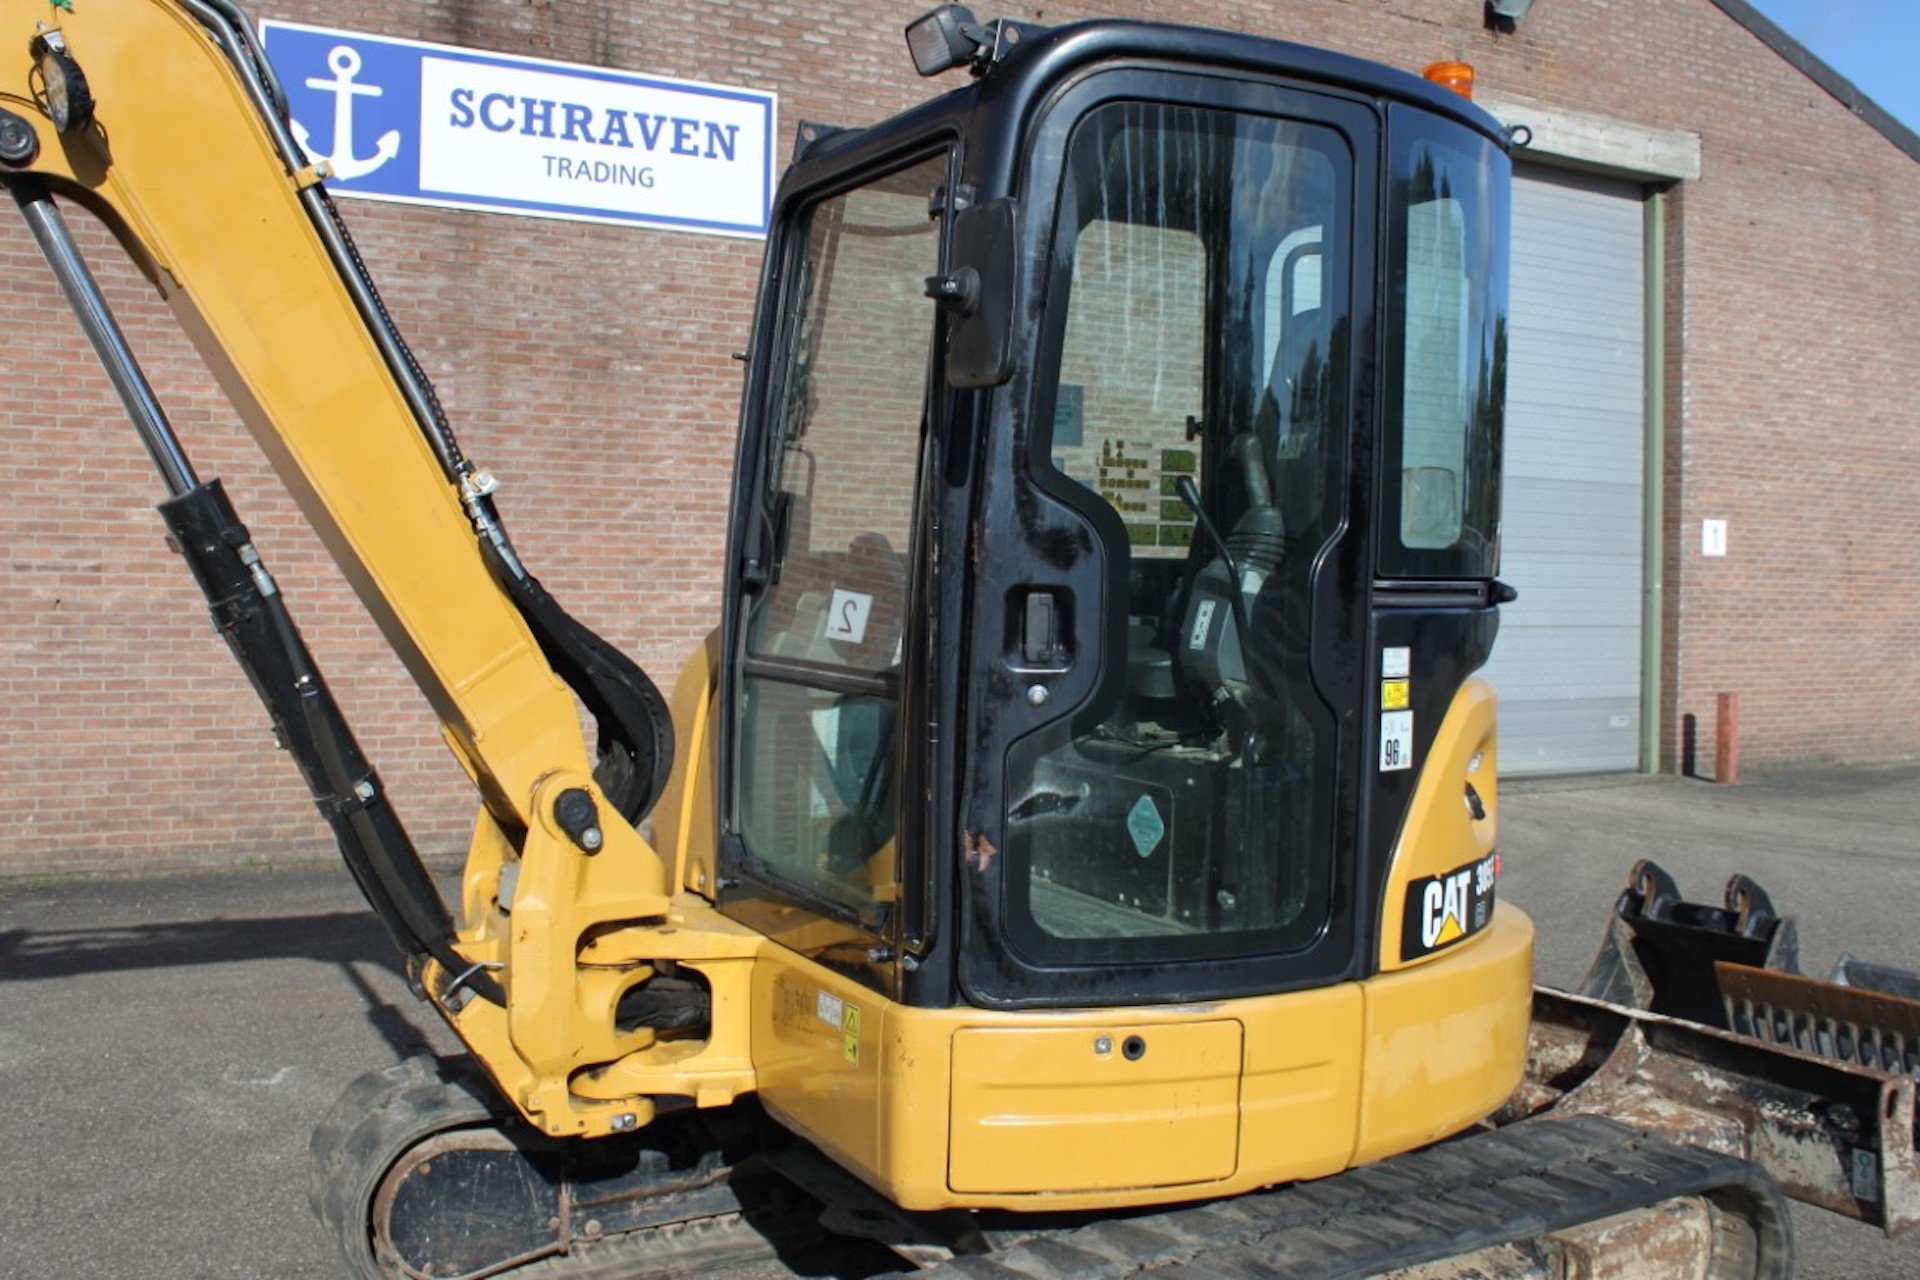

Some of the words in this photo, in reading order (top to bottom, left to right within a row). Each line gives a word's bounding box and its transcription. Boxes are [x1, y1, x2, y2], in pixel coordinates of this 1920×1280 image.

[449, 87, 741, 162] SCHRAVEN
[542, 154, 655, 189] TRADING
[1384, 738, 1401, 767] 96
[1421, 869, 1472, 948] CAT
